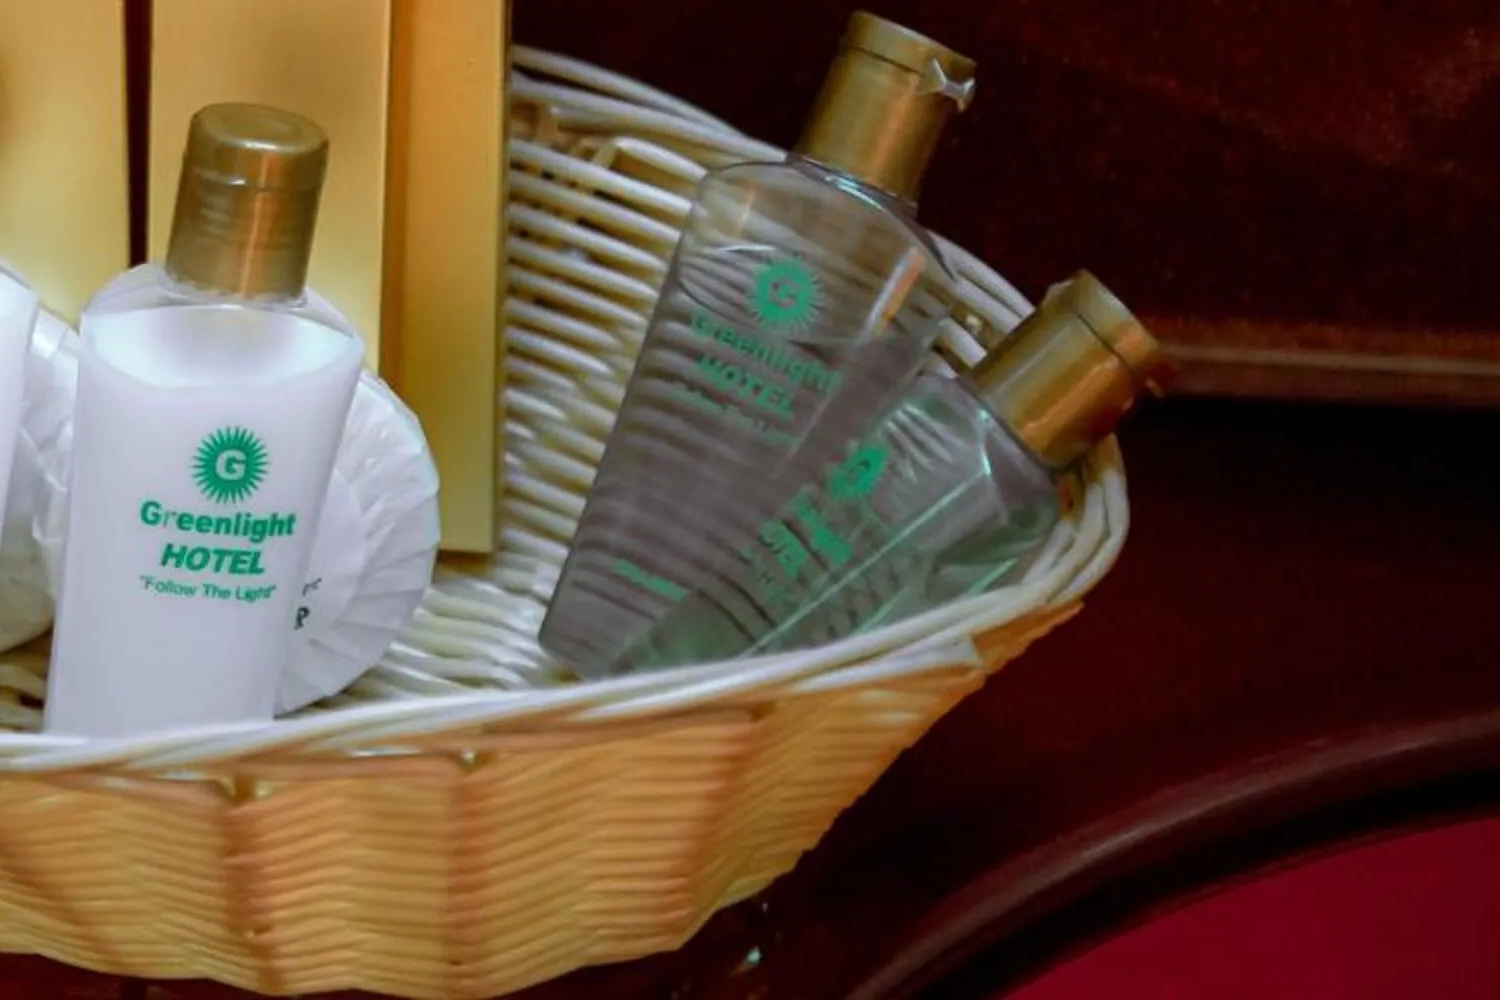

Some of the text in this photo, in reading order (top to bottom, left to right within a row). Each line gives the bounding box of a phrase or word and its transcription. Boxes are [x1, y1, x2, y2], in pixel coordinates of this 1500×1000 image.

[215, 449, 248, 481] G
[140, 500, 297, 544] Greenlight
[160, 543, 266, 576] HOTEL
[201, 582, 232, 601] The
